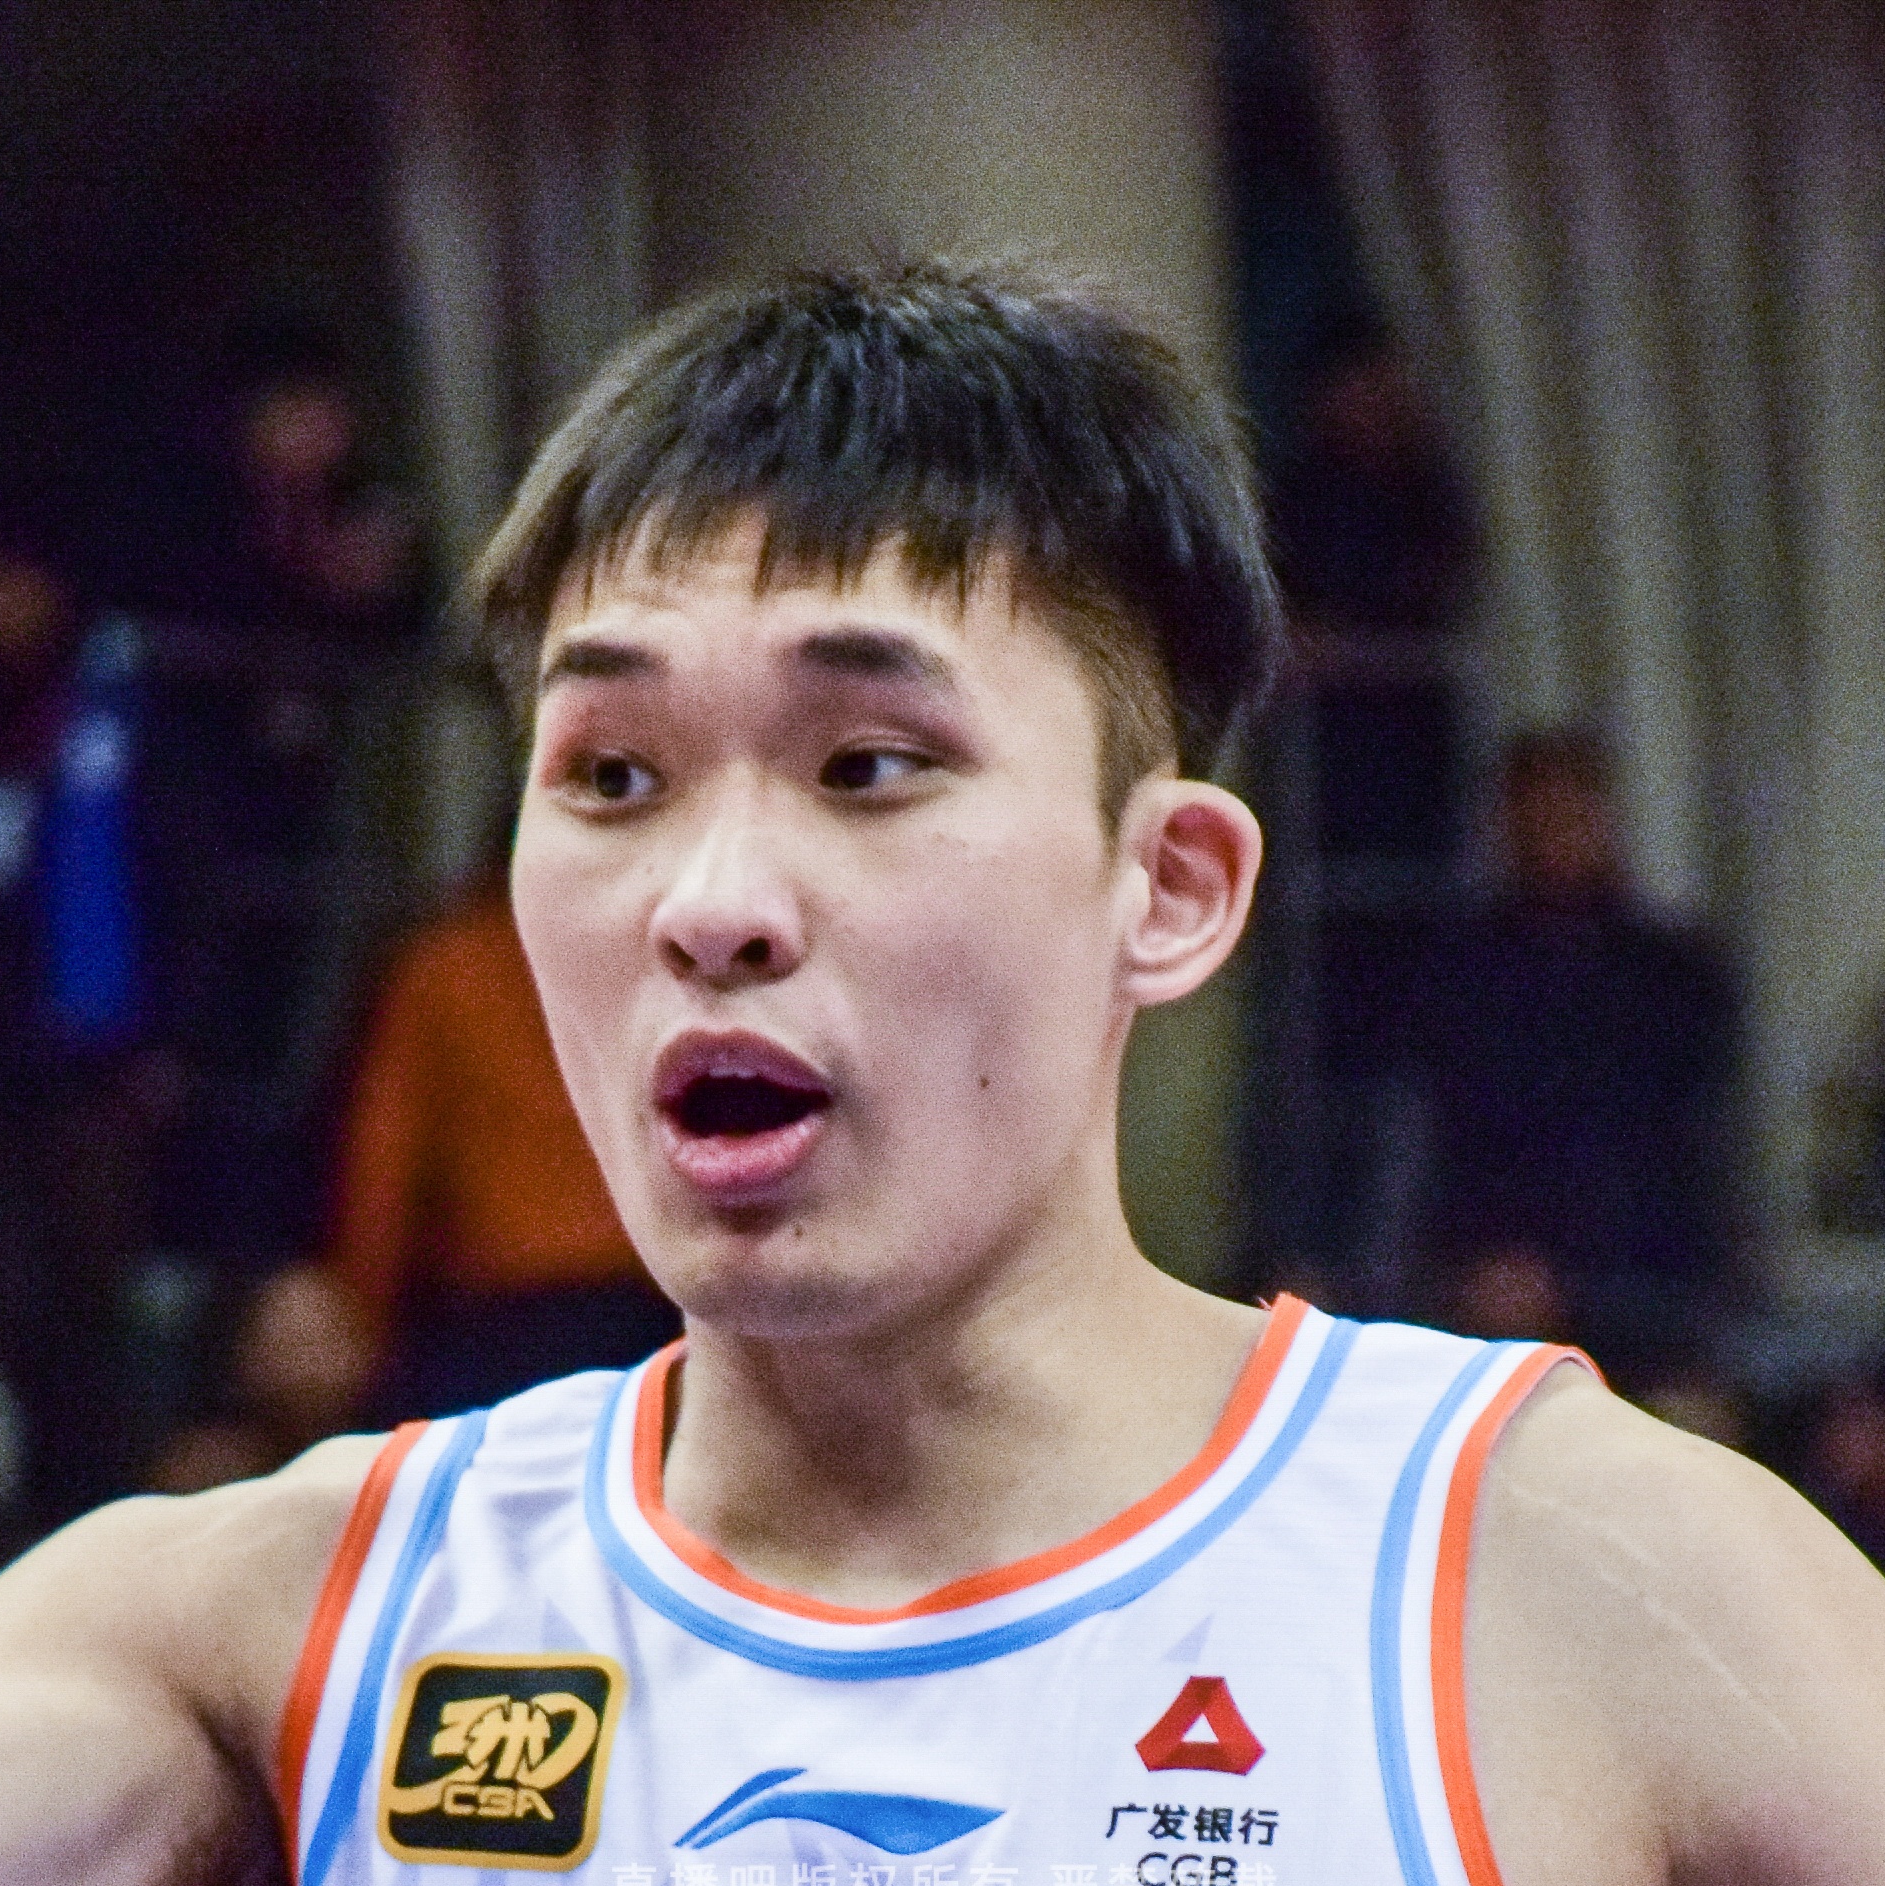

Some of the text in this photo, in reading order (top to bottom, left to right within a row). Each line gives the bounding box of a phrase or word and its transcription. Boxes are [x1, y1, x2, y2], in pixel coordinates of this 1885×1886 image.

[442, 1785, 556, 1822] CBA
[1105, 1803, 1280, 1846] 广发银行
